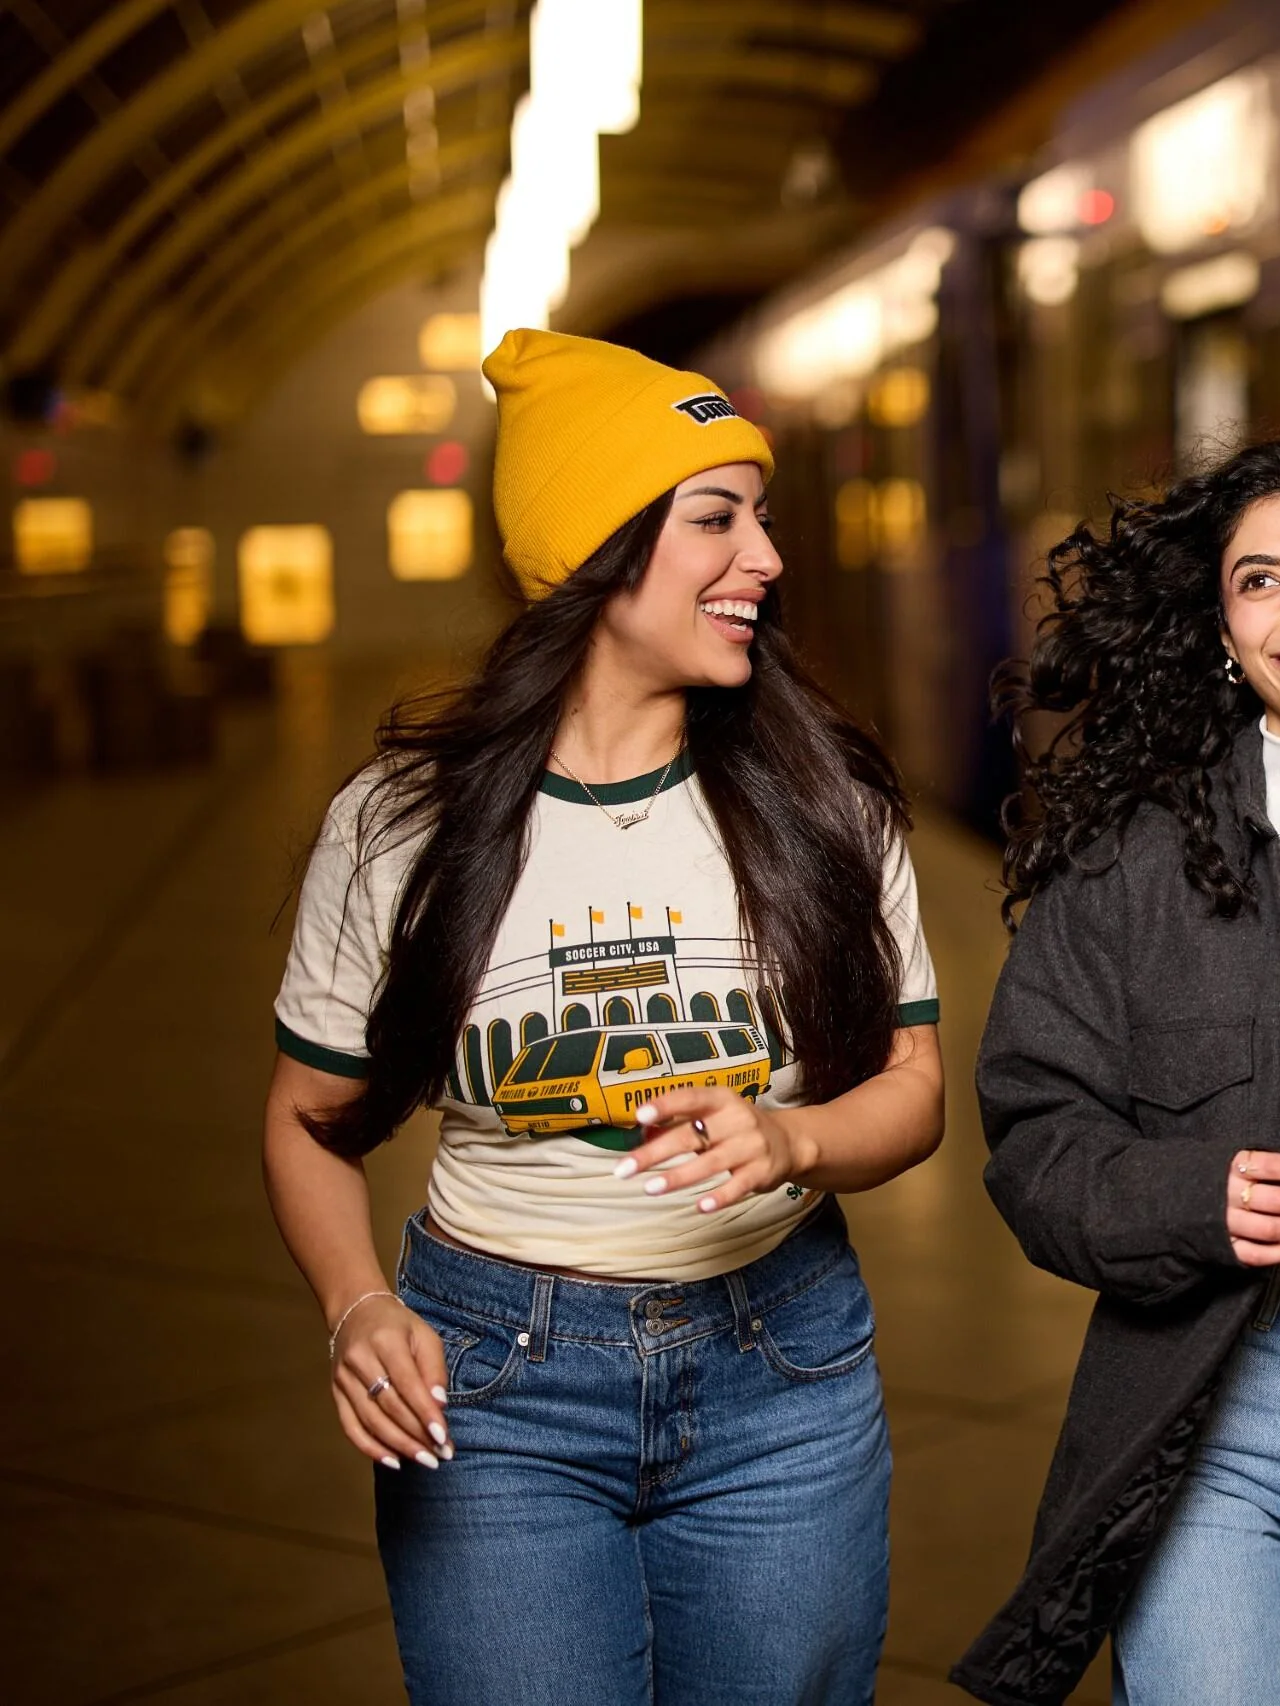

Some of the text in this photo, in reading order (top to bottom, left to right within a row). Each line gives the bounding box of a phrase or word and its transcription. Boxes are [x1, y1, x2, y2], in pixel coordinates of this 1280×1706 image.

[565, 946, 606, 962] SOCCER
[638, 941, 660, 953] USA
[540, 1081, 580, 1097] TIMBERS
[624, 1068, 760, 1112] PORT TIMBERS
